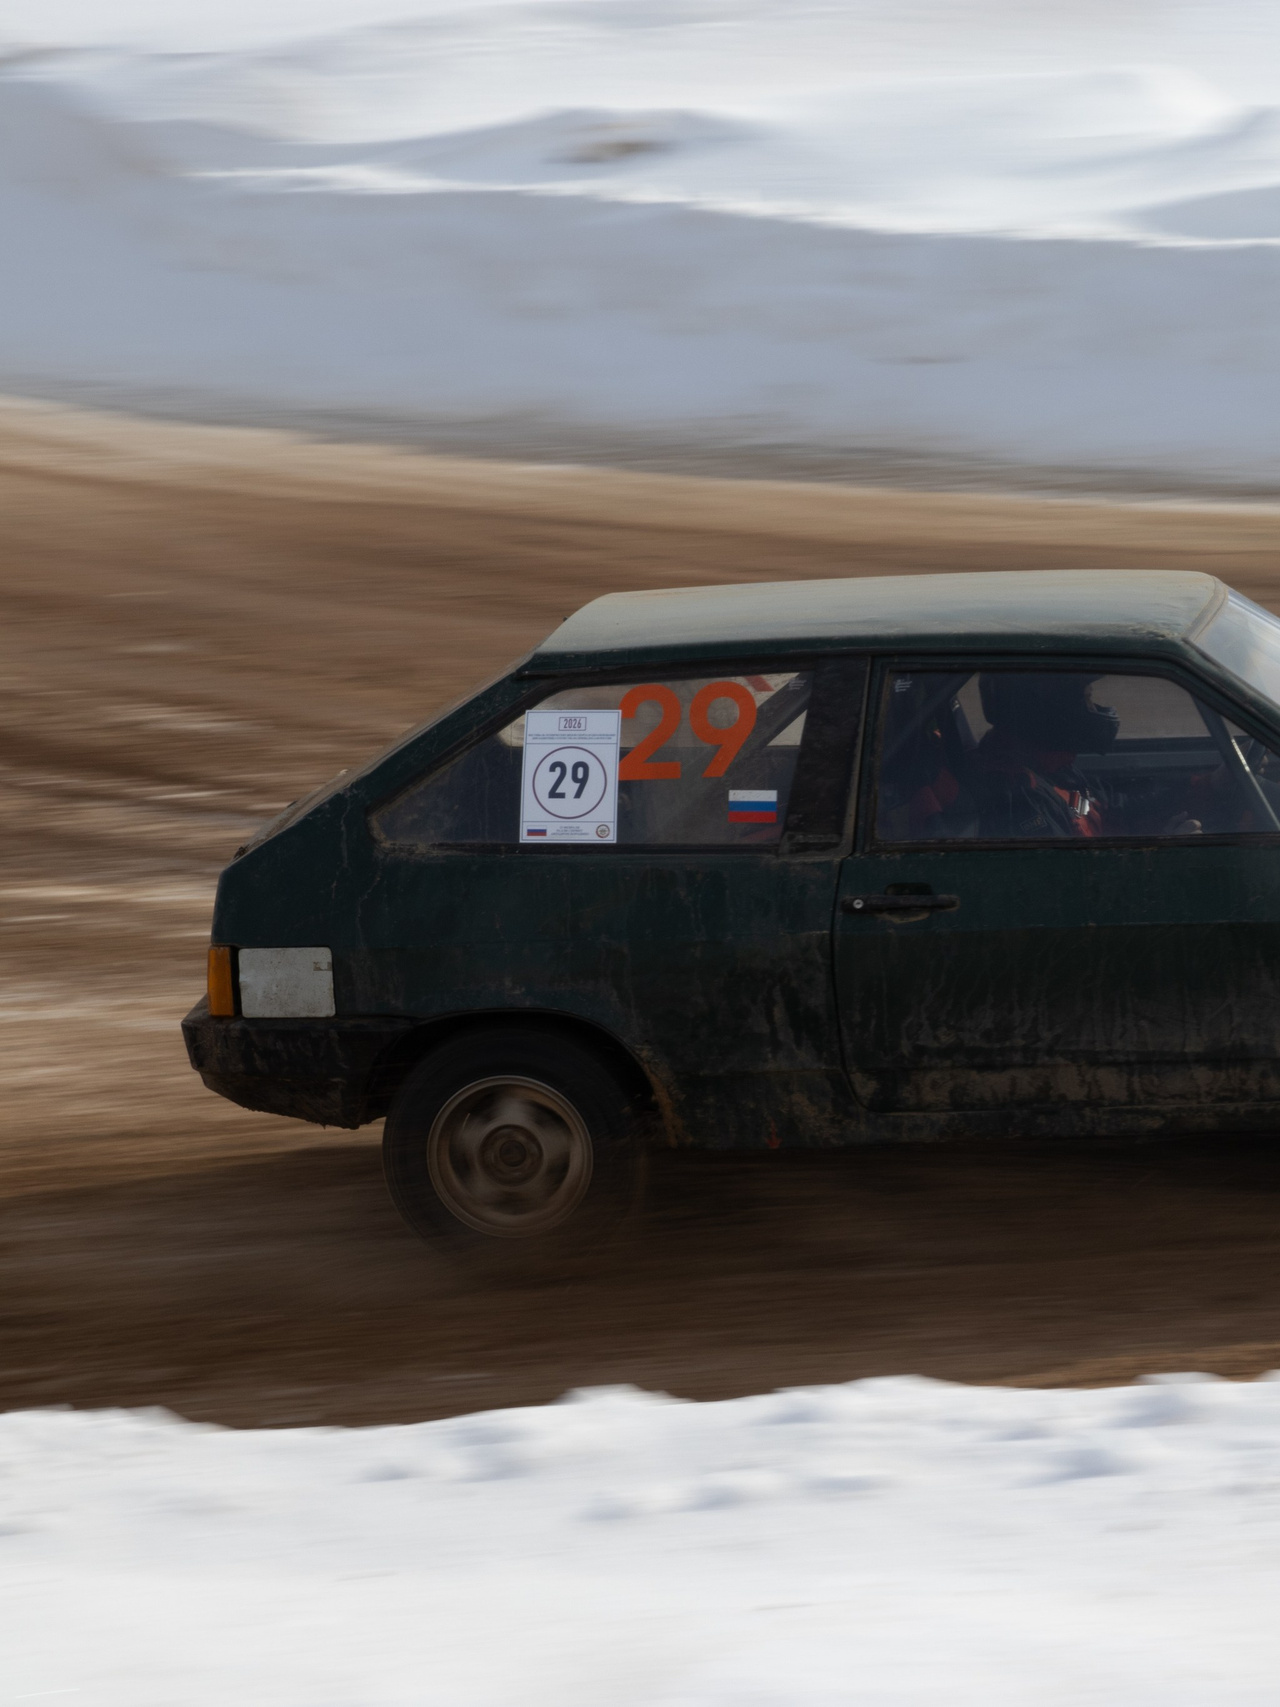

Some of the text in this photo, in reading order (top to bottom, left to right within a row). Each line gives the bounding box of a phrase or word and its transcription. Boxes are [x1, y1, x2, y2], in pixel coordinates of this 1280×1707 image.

[563, 718, 582, 729] 2026
[619, 681, 757, 780] 29
[548, 761, 589, 799] 29
